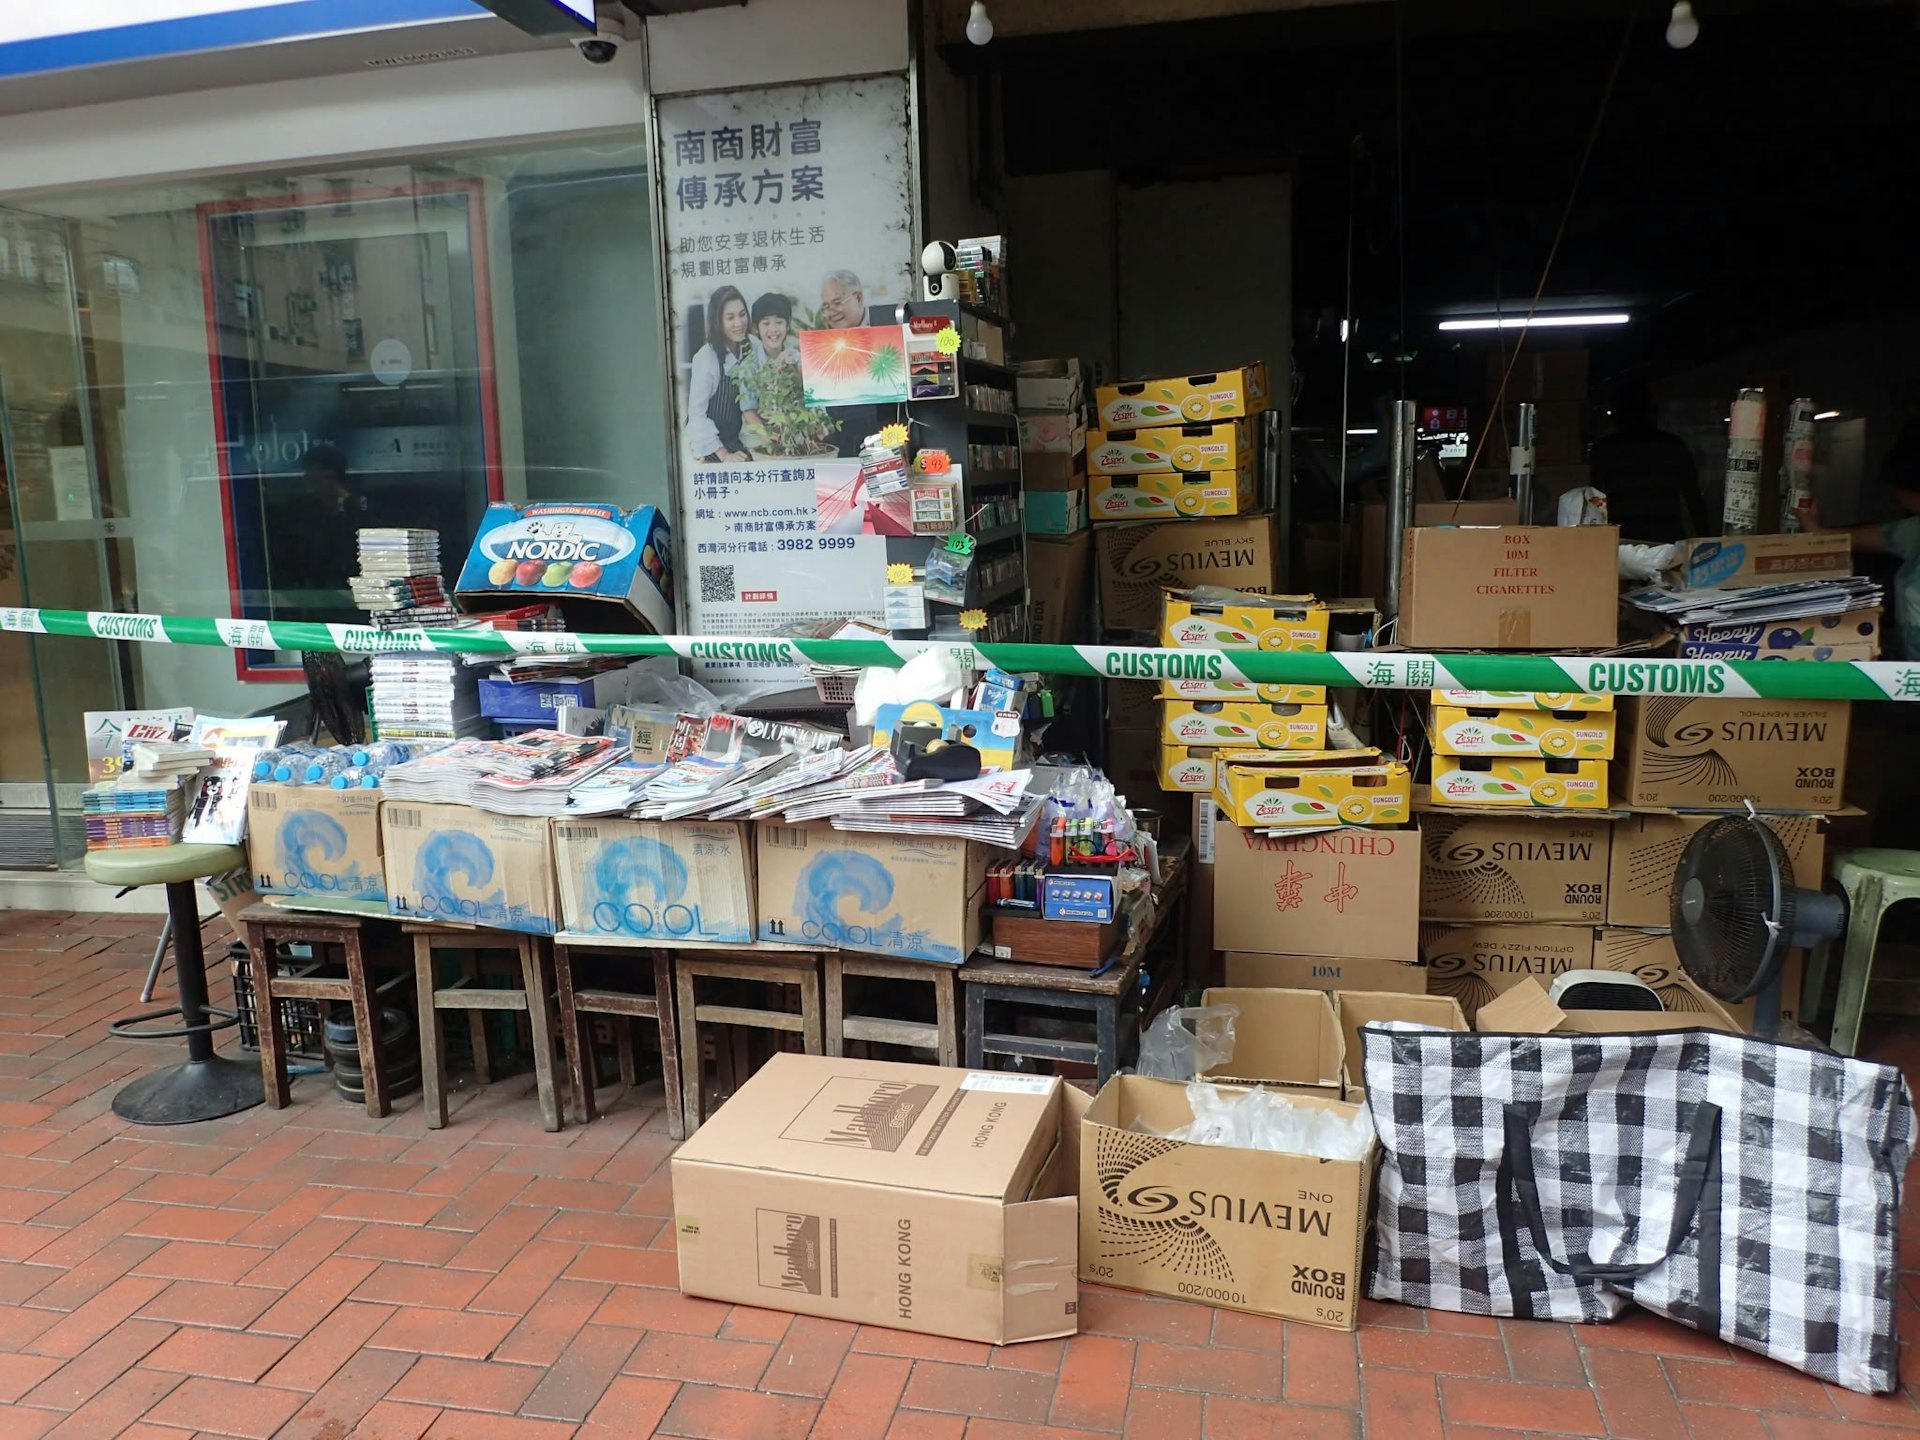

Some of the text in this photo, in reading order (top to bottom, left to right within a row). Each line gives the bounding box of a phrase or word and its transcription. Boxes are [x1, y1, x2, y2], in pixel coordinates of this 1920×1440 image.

[673, 117, 822, 167] 南商財富
[676, 165, 824, 212] 傳承方案
[680, 226, 825, 253] 助您安享退休生活
[680, 255, 787, 279] 規劃財富傳承
[1113, 409, 1138, 422] Zespri
[1101, 455, 1126, 467] Zespri
[693, 468, 815, 486] 詳情請向本分行查詢及
[724, 507, 809, 519] www.ncb.com.hk
[1105, 499, 1129, 511] Zespri
[734, 520, 816, 533] 南商財富傳承方案
[777, 538, 814, 551] 3982
[818, 537, 855, 550] 9999
[1204, 537, 1255, 547] SKY BLUE
[1504, 535, 1530, 545] BOX
[506, 541, 600, 562] NORDIC
[1166, 548, 1255, 572] MEVIUS
[1506, 550, 1529, 560] 10M
[1493, 567, 1538, 578] FILTER
[1476, 585, 1555, 595] CIGARETTES
[97, 616, 158, 638] CUSTOMS
[1181, 630, 1207, 641] Zespri
[343, 630, 422, 651] CUSTOMS
[690, 641, 794, 663] CUSTOMS
[1105, 652, 1222, 680] CUSTOMS
[1366, 660, 1435, 687] 海關
[1588, 662, 1725, 694] CUSTOMS
[1181, 725, 1207, 735] Zespri
[1456, 734, 1484, 744] Zespri
[1722, 722, 1827, 741] MEVIUS
[1180, 772, 1206, 782] Zespri
[1797, 768, 1836, 777] BOX
[1447, 783, 1475, 793] Zespri
[1795, 778, 1834, 789] ROUND
[1256, 804, 1285, 816] Zespri
[1242, 832, 1395, 856] CHUNGHWA
[1492, 842, 1592, 861] MEVIUS
[284, 871, 348, 891] COOL
[1566, 884, 1602, 893] BOX
[421, 895, 490, 919] COOL
[1564, 894, 1602, 904] ROUND
[593, 902, 719, 935] COOL
[1582, 911, 1602, 920] 20's
[802, 920, 883, 946] COOL
[1311, 965, 1341, 978] 10M
[1474, 953, 1572, 974] MEVIUS
[824, 1082, 908, 1147] Marlboro
[971, 1101, 1008, 1148] HONG KONG
[1298, 1189, 1333, 1204] ONE
[1188, 1190, 1332, 1237] MEVIUS
[773, 1214, 804, 1288] Marlboro
[898, 1218, 912, 1319] HONG KONG
[1292, 1264, 1346, 1286] BOX
[1088, 1264, 1114, 1278] 20's
[1316, 1307, 1343, 1322] 20's
[1291, 1281, 1345, 1300] ROUND
